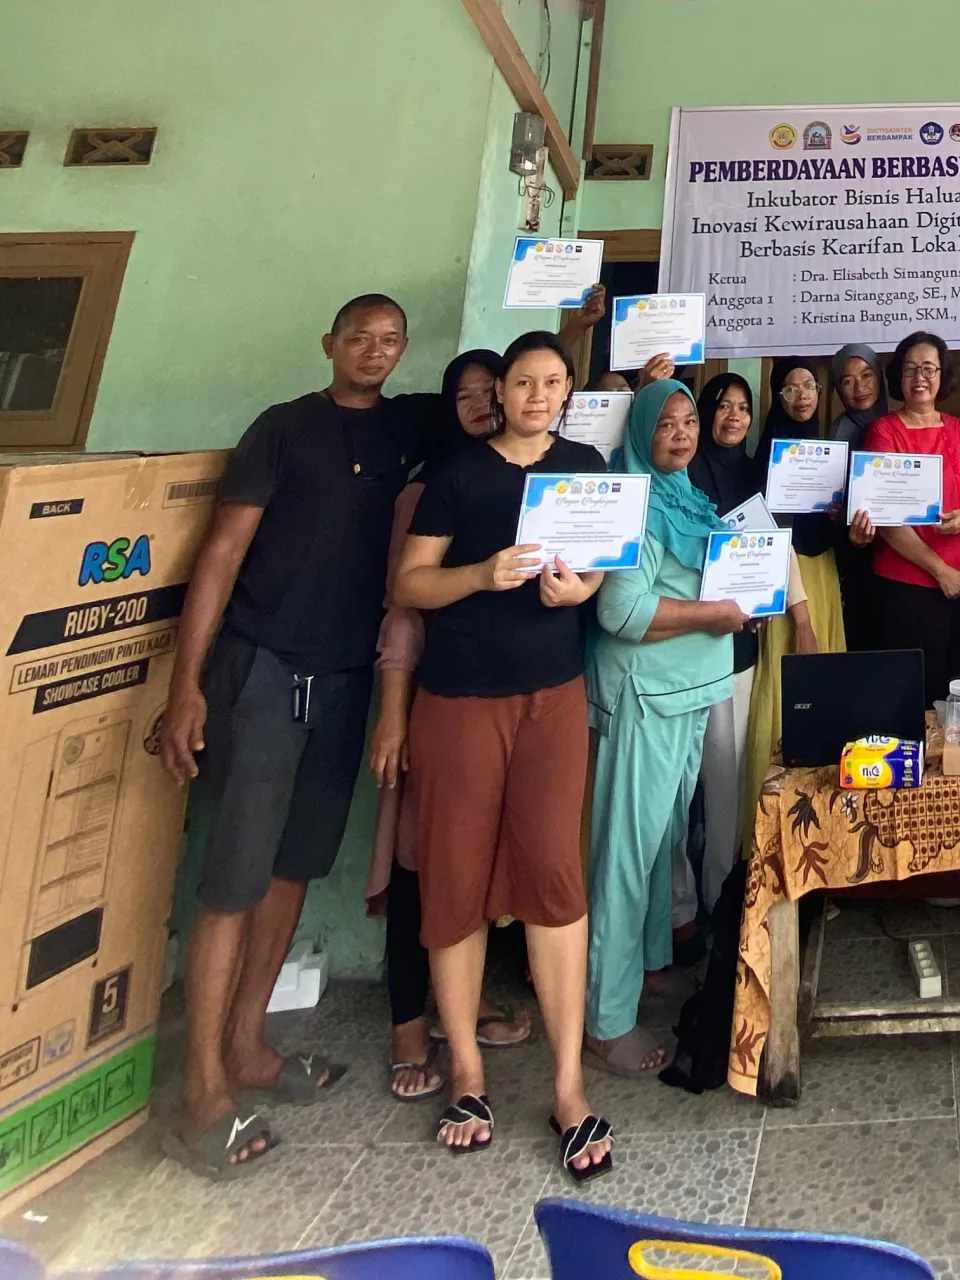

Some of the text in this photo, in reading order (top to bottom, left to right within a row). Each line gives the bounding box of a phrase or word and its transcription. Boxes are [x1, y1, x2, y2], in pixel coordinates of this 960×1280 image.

[688, 157, 867, 183] PEMBERDAYAAN
[746, 189, 838, 209] Inkubator
[844, 187, 900, 206] Bisnis
[691, 216, 758, 235] Inovasi
[763, 211, 910, 233] Kewirausahaan
[739, 239, 816, 258] Berbasis
[821, 236, 905, 256] Kearifan
[708, 272, 747, 285] Ketua
[800, 270, 829, 282] Dra.
[832, 267, 889, 282] Elisabeth
[707, 293, 764, 311] Anggota
[800, 290, 840, 303] Darna
[844, 289, 919, 306] Sitanggang,
[922, 286, 947, 301] SE.,
[706, 314, 763, 332] Anggota
[766, 316, 775, 325] 2
[801, 310, 856, 325] Kristina
[859, 309, 912, 327] Bangun,
[915, 306, 957, 322] SKM.,
[41, 503, 72, 515] BACK
[78, 534, 151, 587] RSA
[63, 595, 149, 638] RUBY-200
[17, 631, 172, 686] LEMARI PENDINGIN PINTU KACA
[42, 664, 140, 706] SHOWCASE COOLER
[793, 702, 813, 710] acer
[101, 976, 119, 1013] 5
